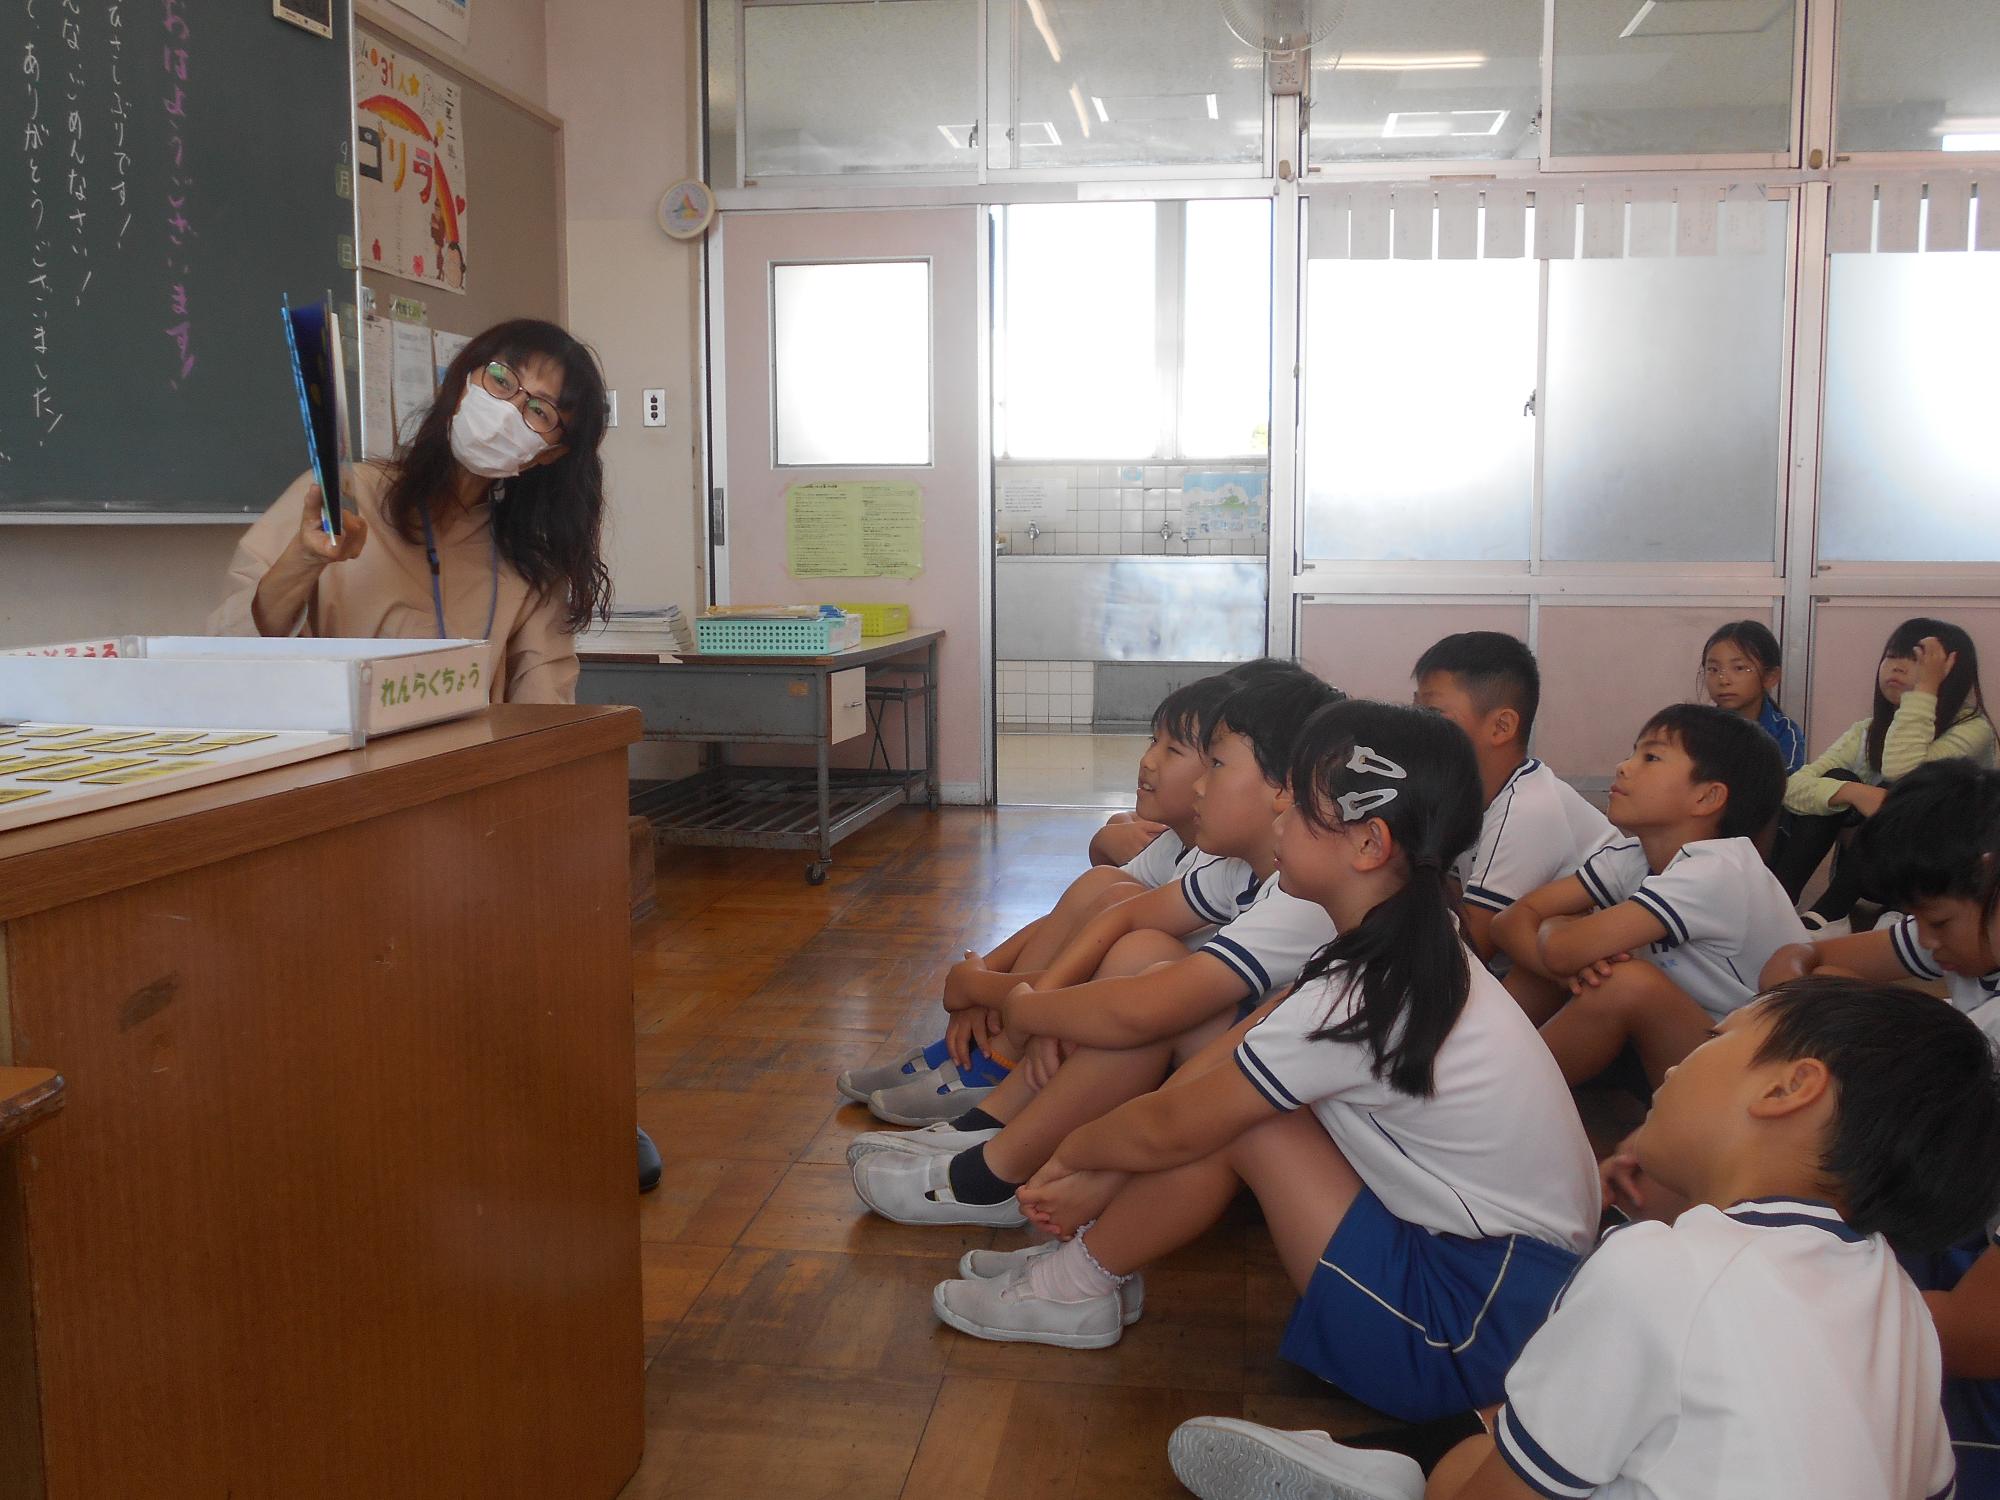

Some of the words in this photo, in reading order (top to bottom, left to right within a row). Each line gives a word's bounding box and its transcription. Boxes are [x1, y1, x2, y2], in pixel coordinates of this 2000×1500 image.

[380, 661, 481, 707] れんらくちょう
